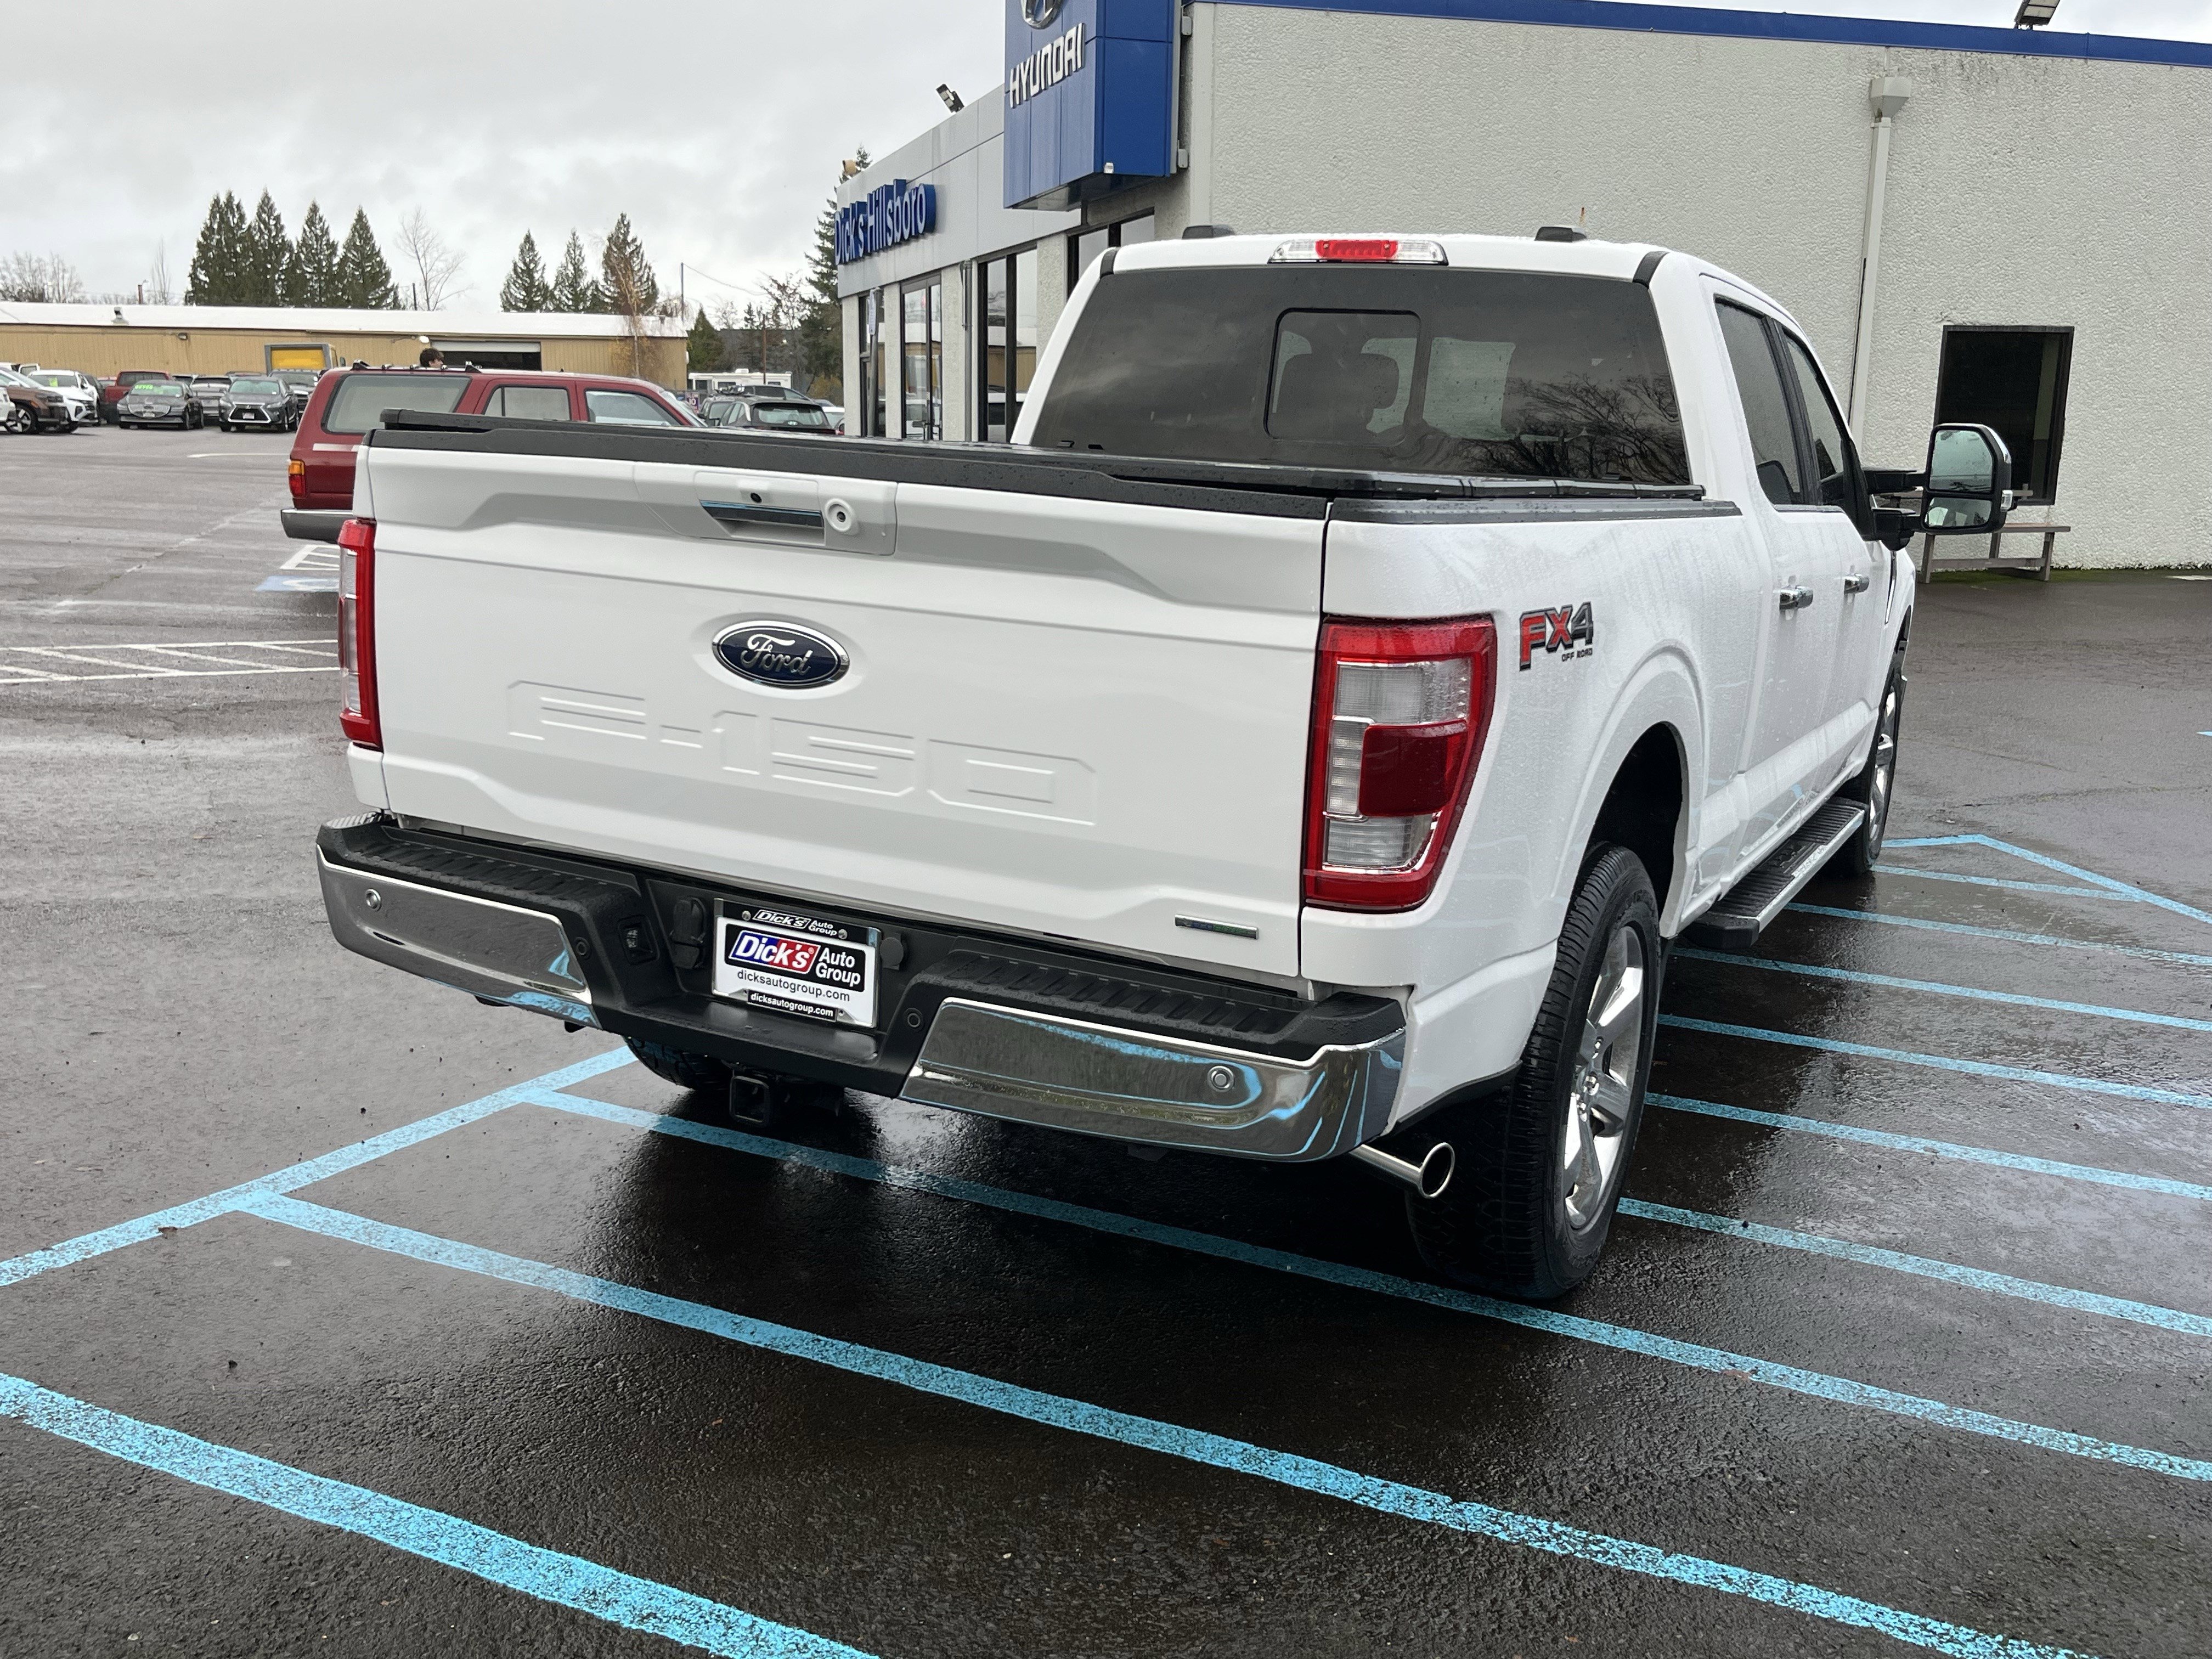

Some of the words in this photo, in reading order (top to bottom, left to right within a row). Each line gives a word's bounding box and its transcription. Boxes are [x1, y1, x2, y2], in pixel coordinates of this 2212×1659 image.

[1009, 22, 1085, 108] HYUNDAI
[834, 201, 865, 266] Dick's
[867, 178, 927, 253] Hillsboro
[1519, 601, 1594, 672] FX4
[741, 634, 814, 676] Ford
[1561, 651, 1575, 662] OFF
[507, 680, 1097, 826] F-150
[757, 911, 807, 928] Dick's
[808, 925, 838, 937] Group
[811, 919, 834, 929] Auto
[735, 934, 810, 969] Dick's
[819, 947, 855, 968] Auto
[737, 969, 850, 1002] dicksautogroup.com
[815, 961, 861, 988] Group
[750, 992, 834, 1017] dicksautogroup.com
